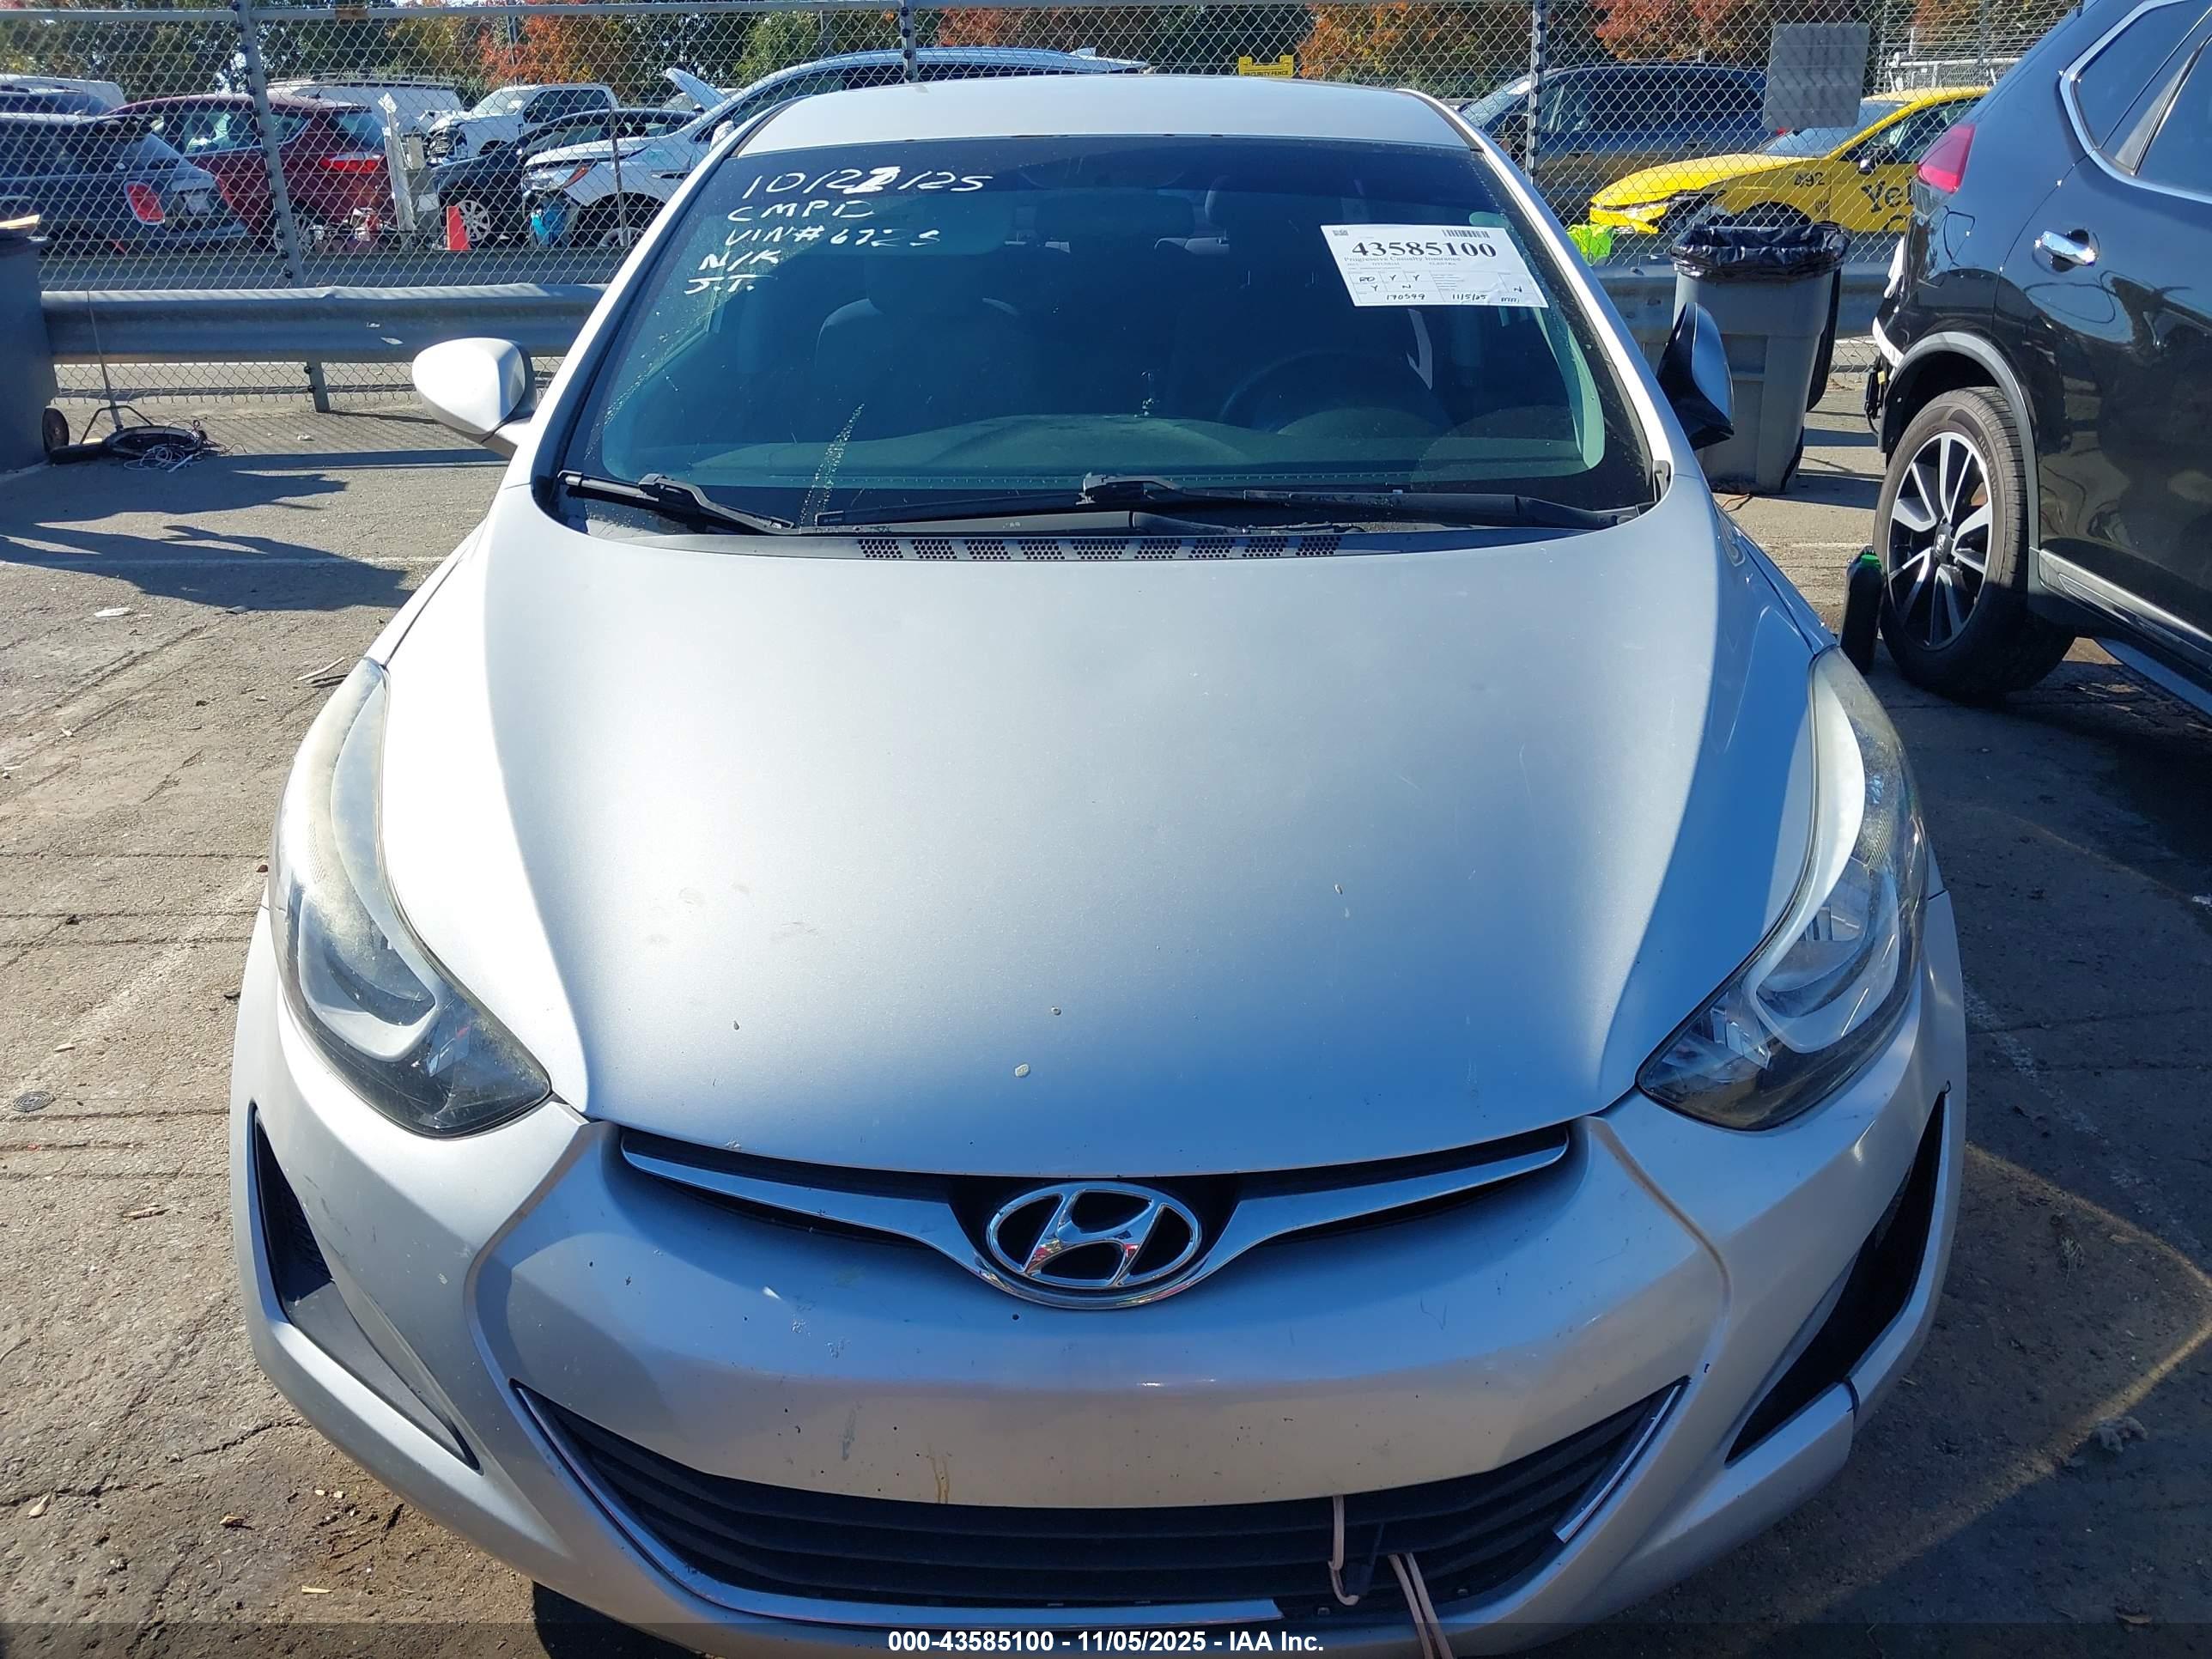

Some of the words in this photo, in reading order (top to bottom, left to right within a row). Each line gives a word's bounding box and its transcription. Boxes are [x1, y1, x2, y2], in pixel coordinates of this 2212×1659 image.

[1794, 172, 1826, 187] 492
[727, 199, 876, 222] CMPD
[1352, 241, 1497, 258] 43585100
